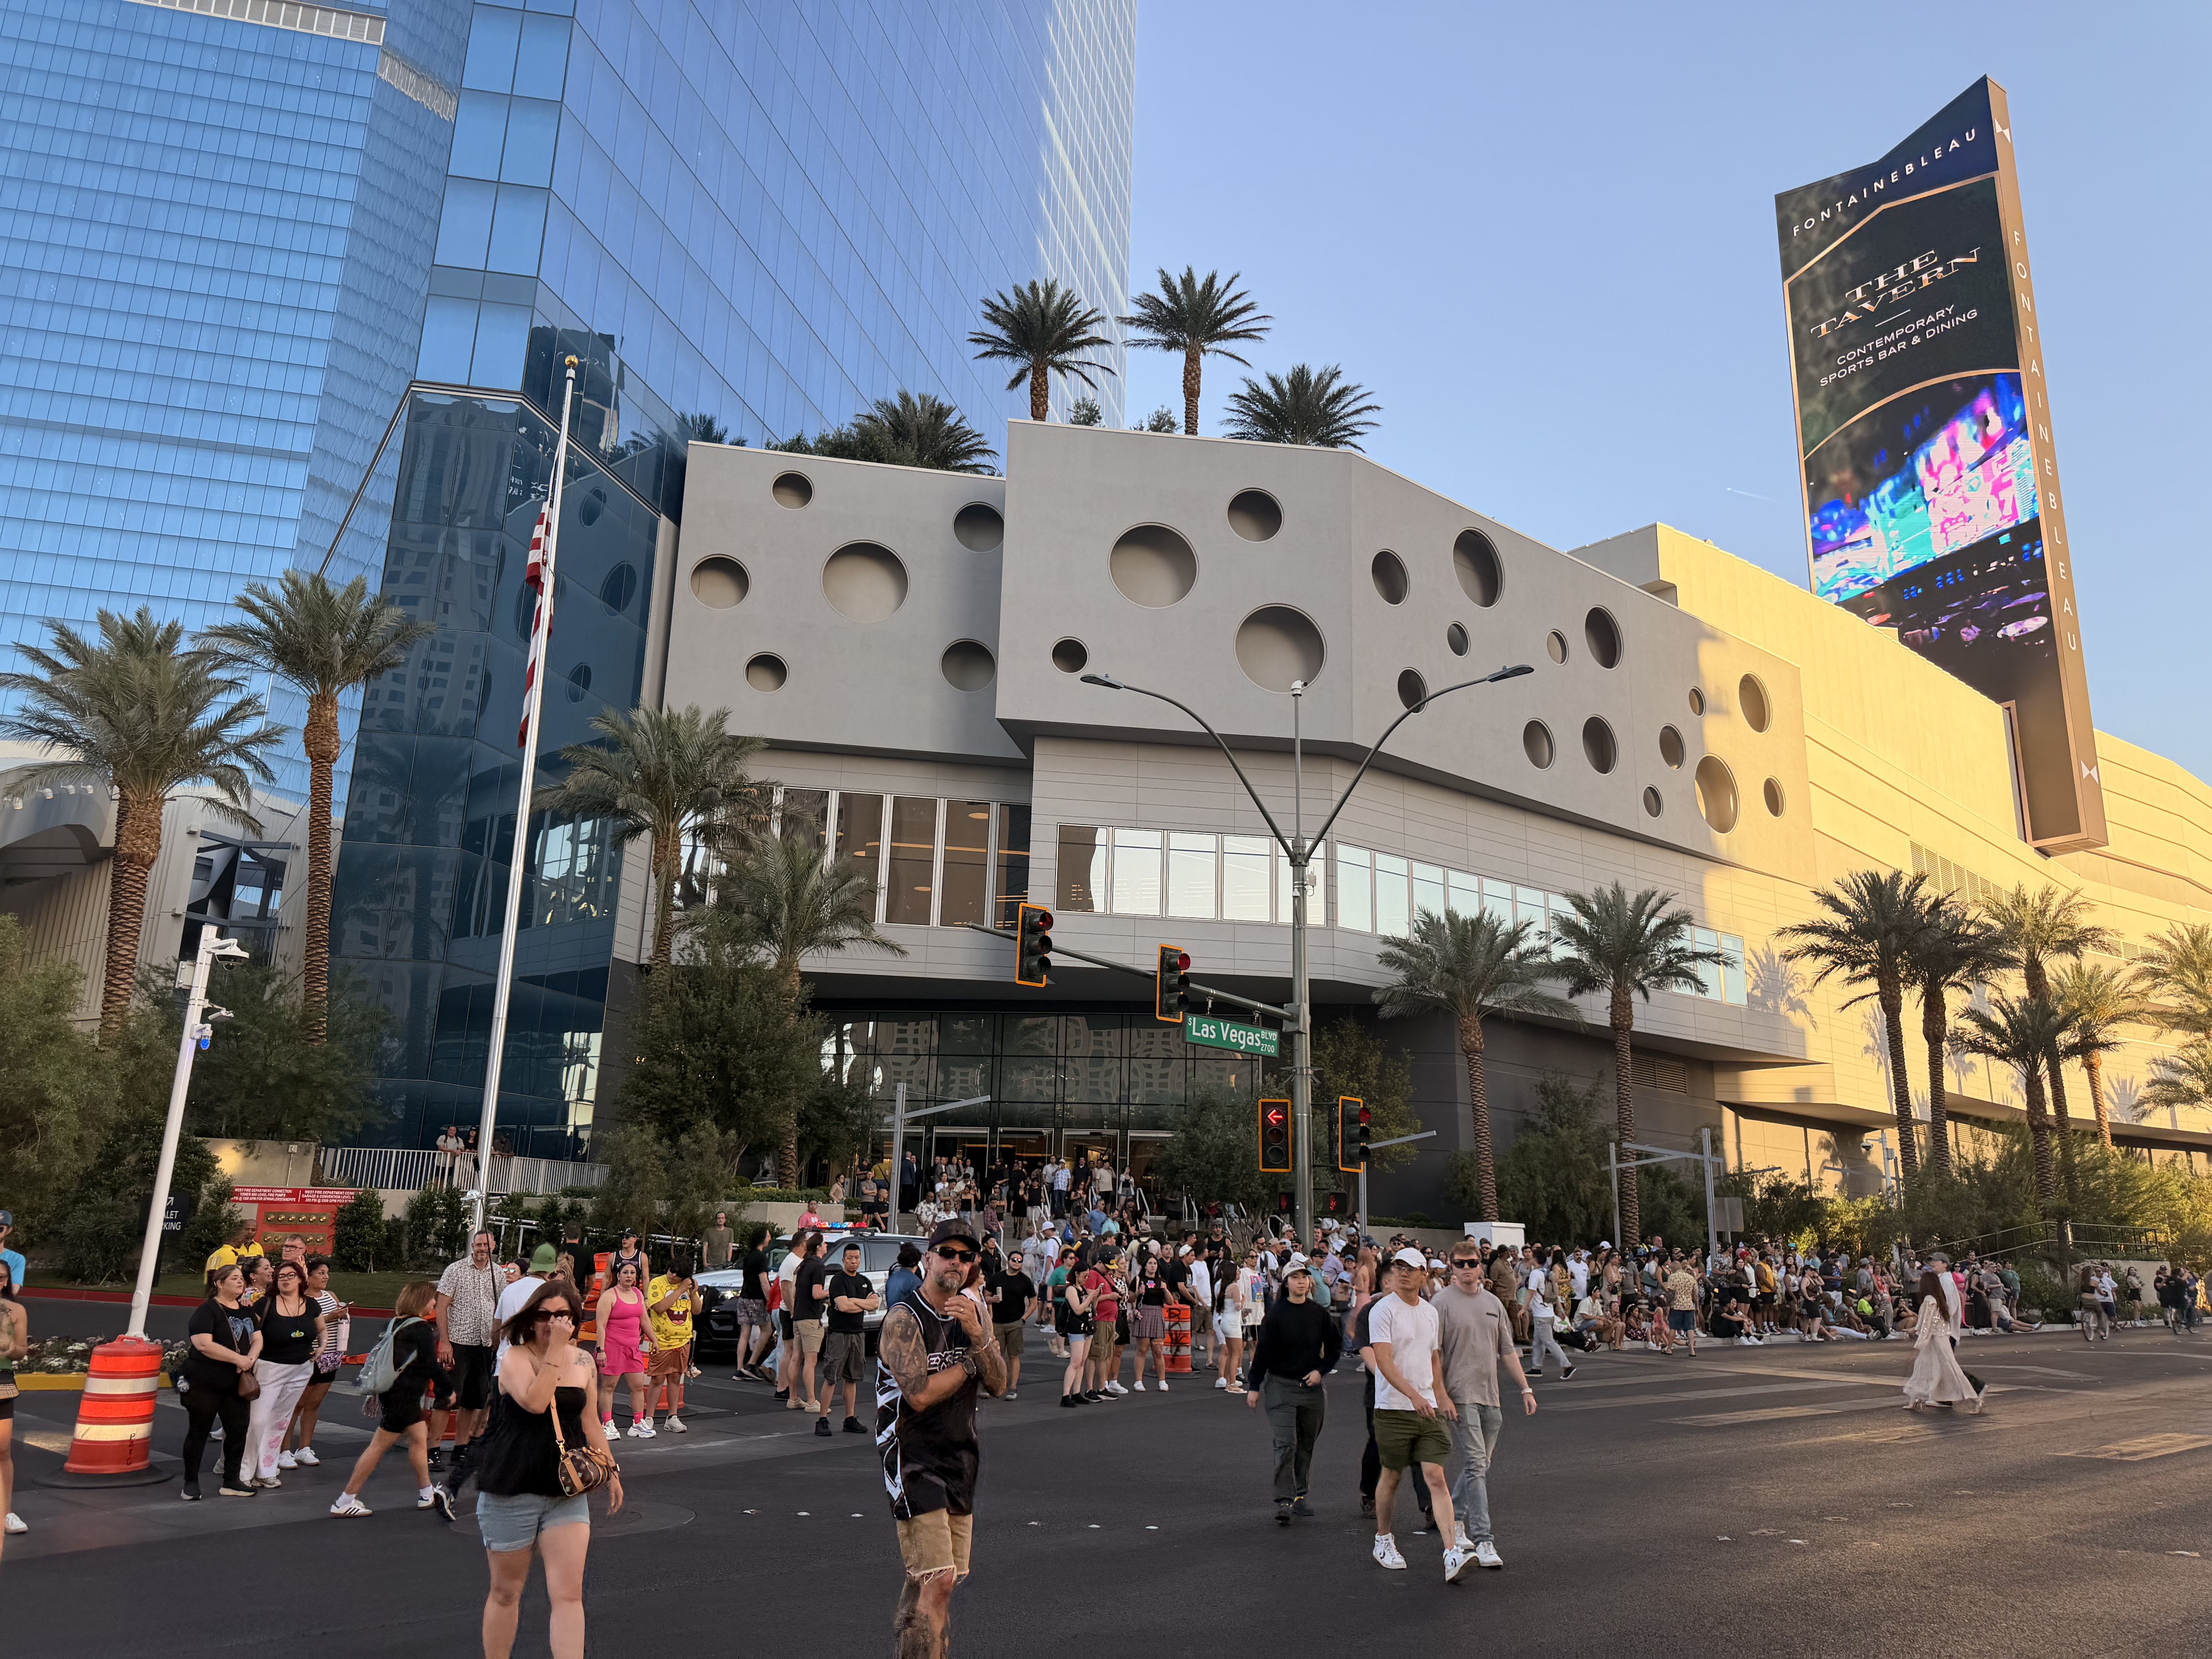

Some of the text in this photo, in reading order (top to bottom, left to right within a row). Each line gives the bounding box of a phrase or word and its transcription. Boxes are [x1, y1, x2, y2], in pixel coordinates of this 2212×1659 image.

[1793, 128, 1976, 236] FONTAINEBLEAU
[1810, 247, 1981, 338] TAVERN
[1845, 250, 1937, 302] THE
[1820, 309, 1978, 386] SPORTS BAR & DINING
[1837, 304, 1954, 365] CONTEMPORARY
[2014, 230, 2076, 651] FONTAINEBLEAU
[1192, 1017, 1216, 1039] Las
[1220, 1022, 1261, 1049] Vegas
[1261, 1031, 1277, 1041] BLVD
[1261, 1043, 1274, 1053] 2700
